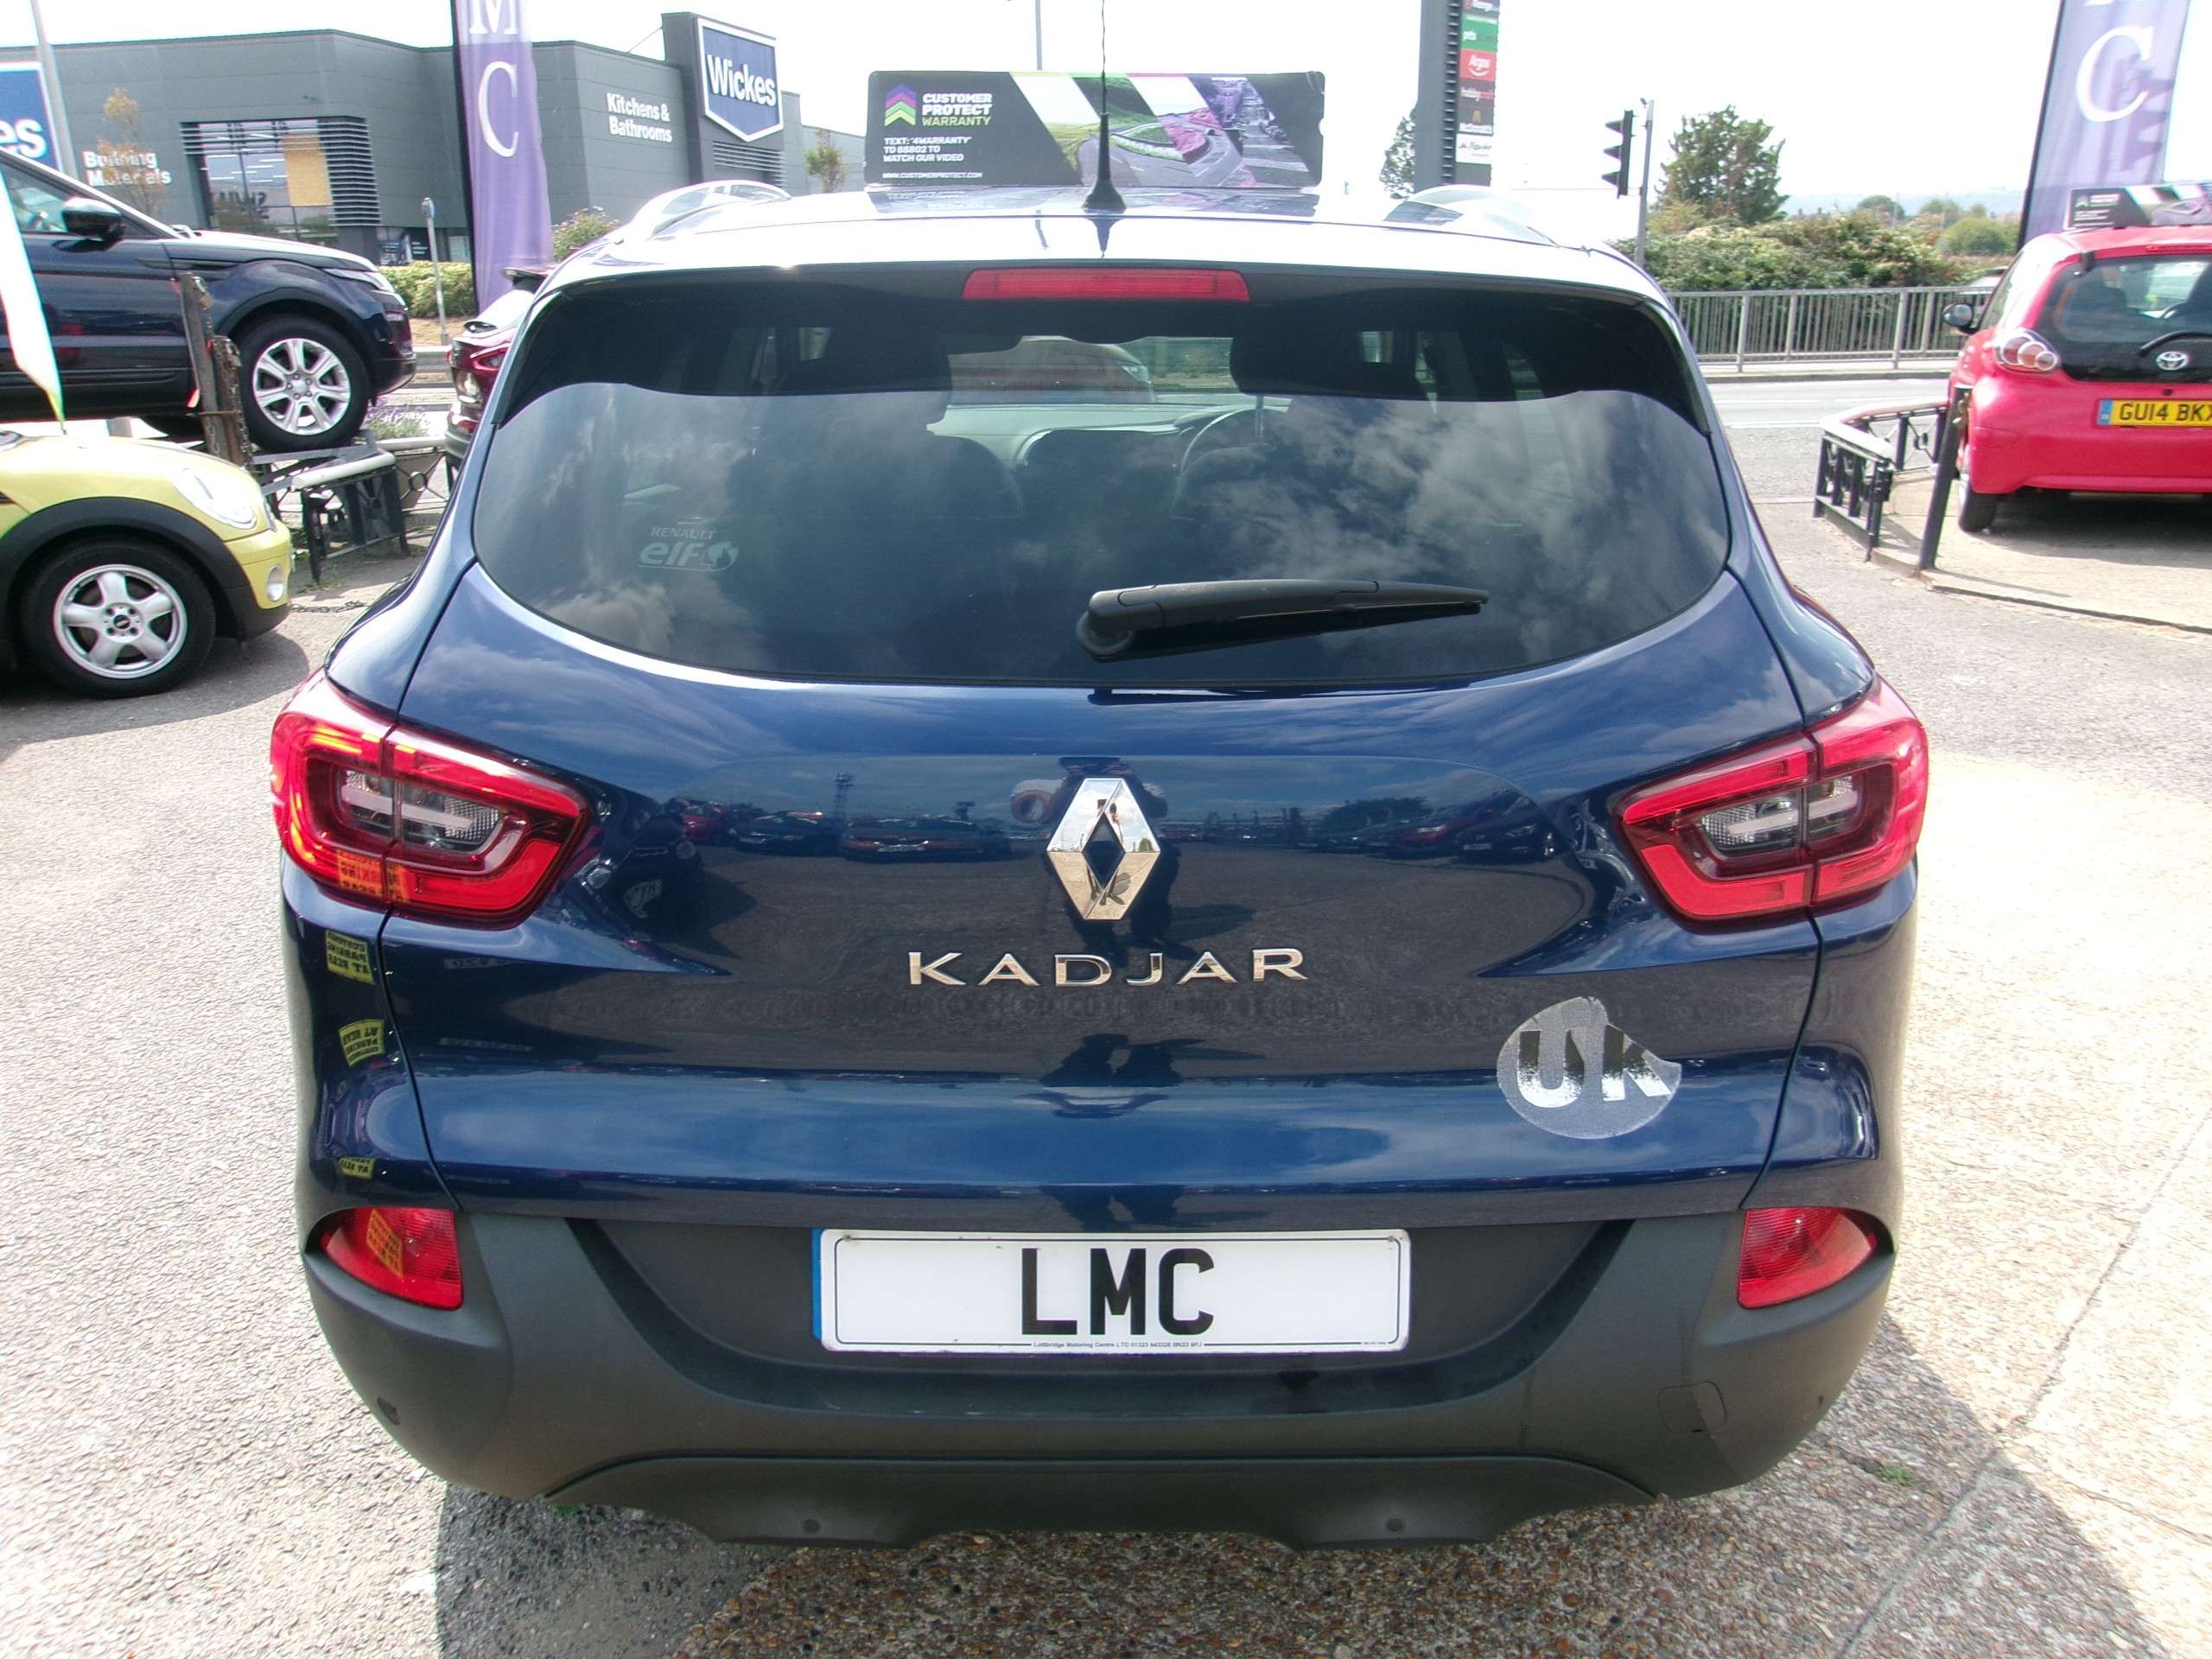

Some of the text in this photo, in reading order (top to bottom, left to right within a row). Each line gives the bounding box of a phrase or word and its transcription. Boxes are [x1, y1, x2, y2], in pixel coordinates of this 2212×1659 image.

[706, 54, 777, 107] Wickes
[607, 92, 671, 122] Kitchens &
[922, 92, 993, 104] CUSTOMER
[921, 104, 993, 116] PROTECT
[608, 115, 673, 143] Bathrooms
[921, 116, 993, 126] WARRANTY
[882, 154, 915, 162] WATCH
[936, 153, 965, 162] VIDEO
[883, 145, 897, 154] TO
[928, 144, 941, 153] TO
[86, 168, 173, 187] Mterals
[2119, 403, 2170, 422] GU14
[650, 526, 718, 540] RENAULT
[639, 541, 704, 567] elf
[907, 947, 1309, 988] KADJAR
[1516, 1023, 1675, 1108] UK
[1021, 1248, 1215, 1336] LMC
